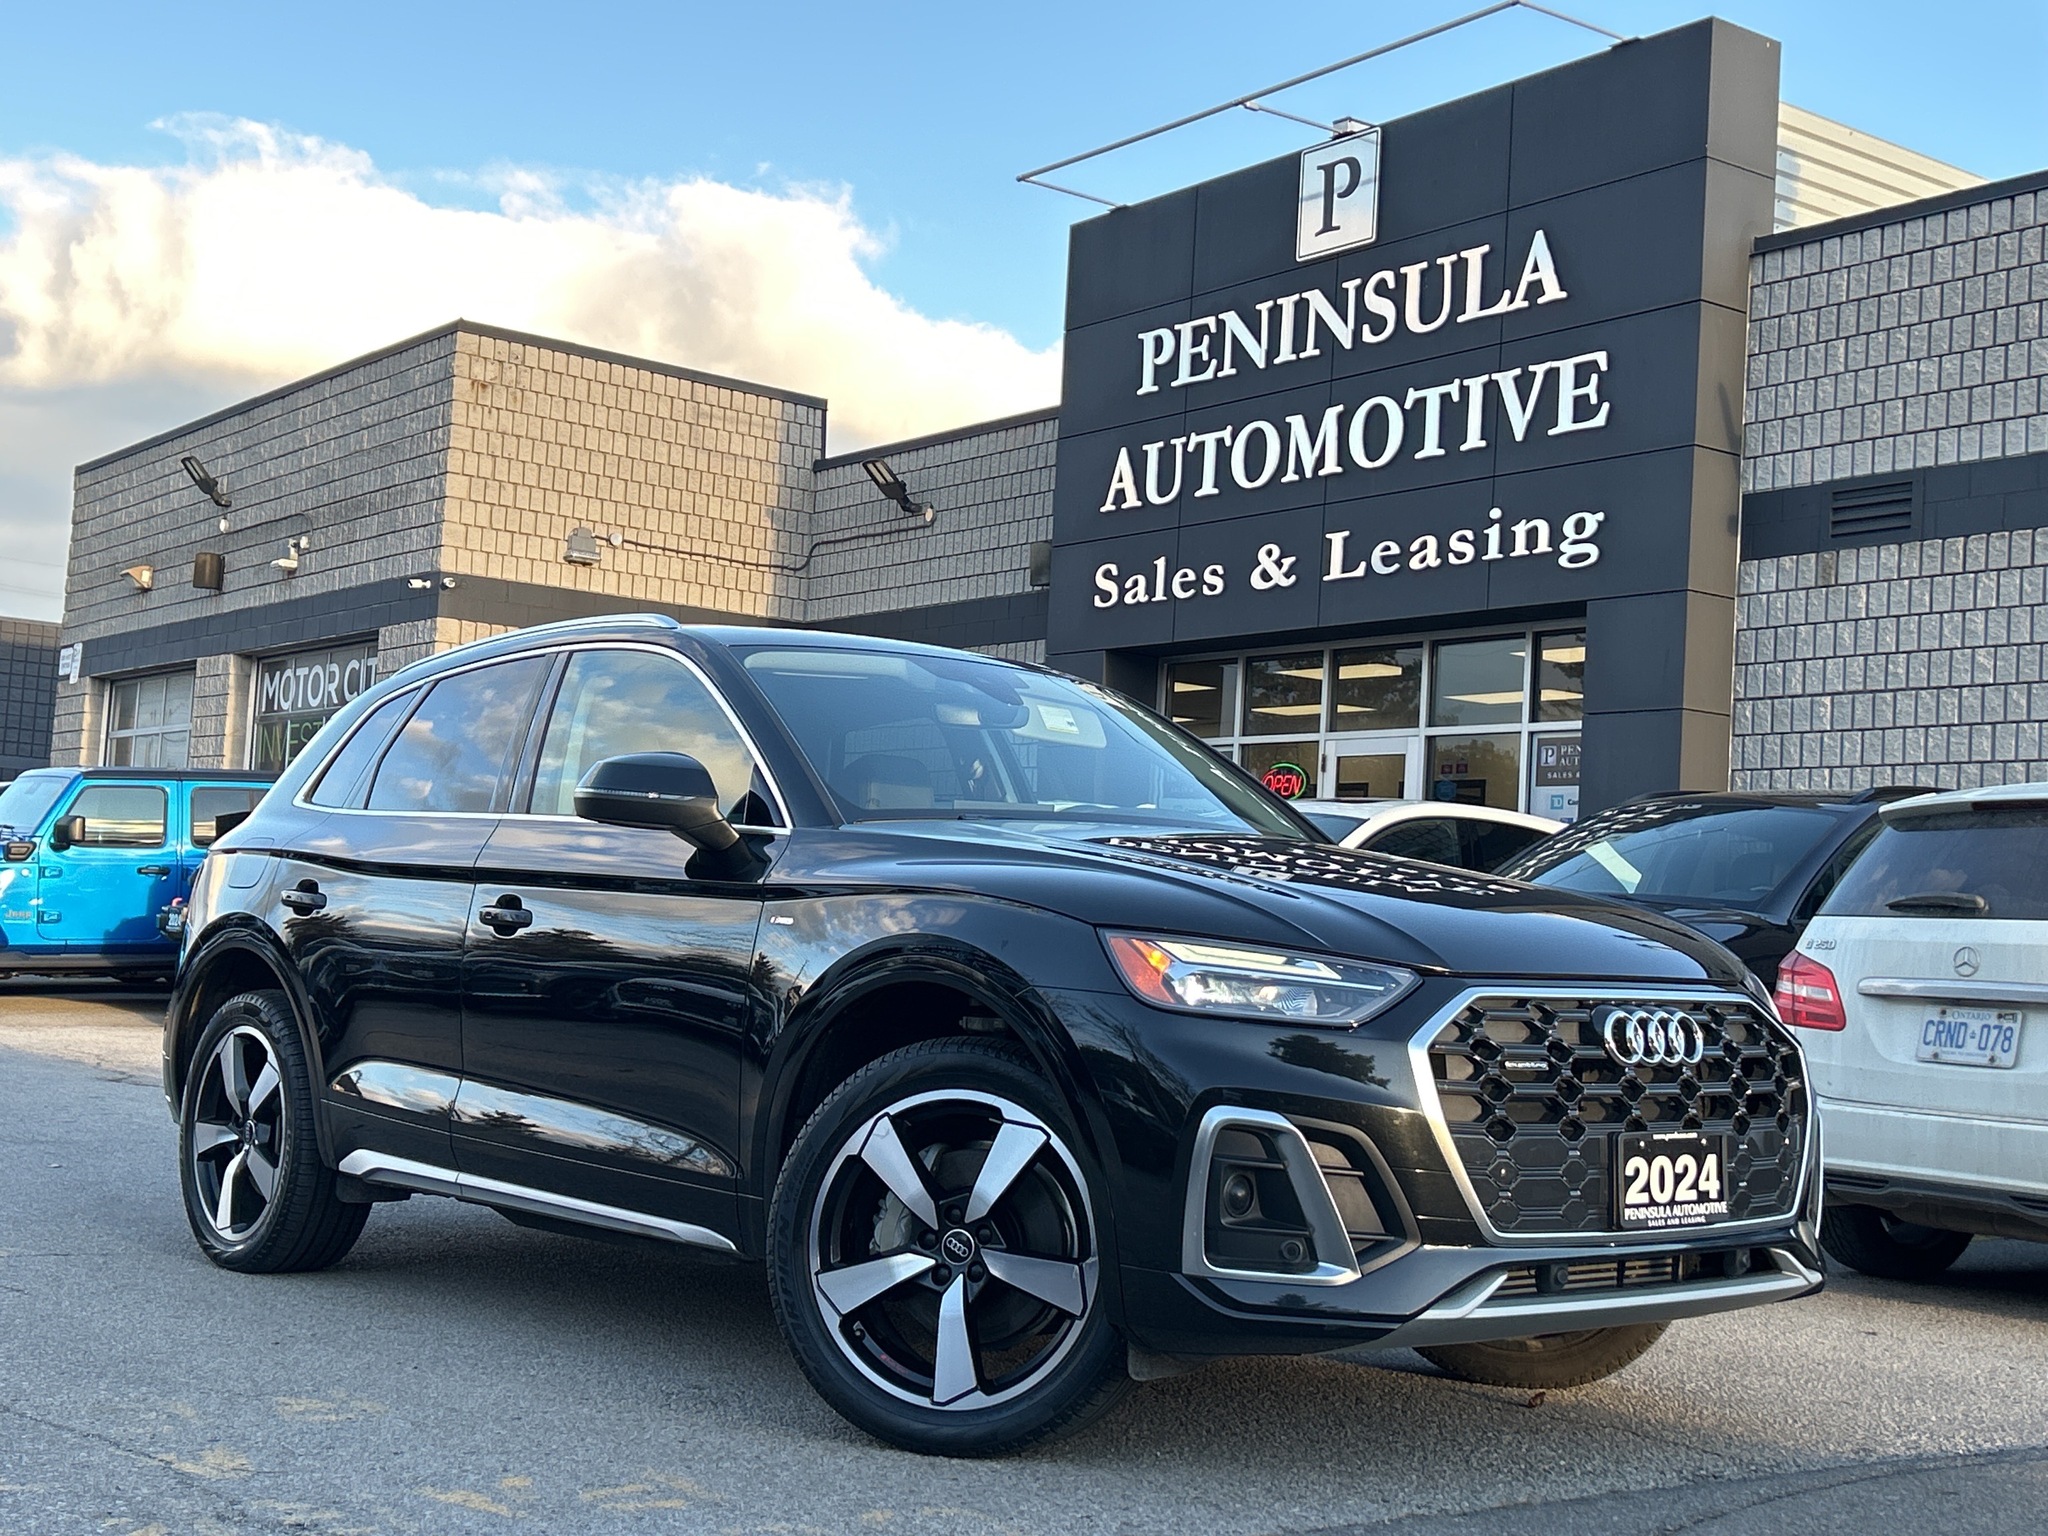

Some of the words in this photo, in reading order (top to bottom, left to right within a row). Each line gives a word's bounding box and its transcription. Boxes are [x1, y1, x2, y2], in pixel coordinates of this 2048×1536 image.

[1315, 156, 1362, 238] P
[1136, 229, 1568, 396] PENINSULA
[1099, 350, 1611, 513] AUTOMOTIVE
[1093, 556, 1226, 608] Sales
[1249, 543, 1298, 590] &
[1322, 508, 1606, 583] Leasing
[262, 661, 340, 713] MOTOR
[1263, 774, 1303, 796] OPEN
[1547, 770, 1573, 780] SALES
[1922, 1019, 1969, 1049] CRND
[1977, 1023, 2015, 1054] 078
[1951, 1010, 1992, 1022] ONTARIO
[1624, 1153, 1721, 1205] 2024
[1623, 1204, 1673, 1221] PENINSULA
[1671, 1200, 1729, 1217] AUTOMOTIVE
[1647, 1217, 1667, 1228] SALES
[1667, 1216, 1680, 1226] AND
[1680, 1215, 1707, 1225] LEASING
